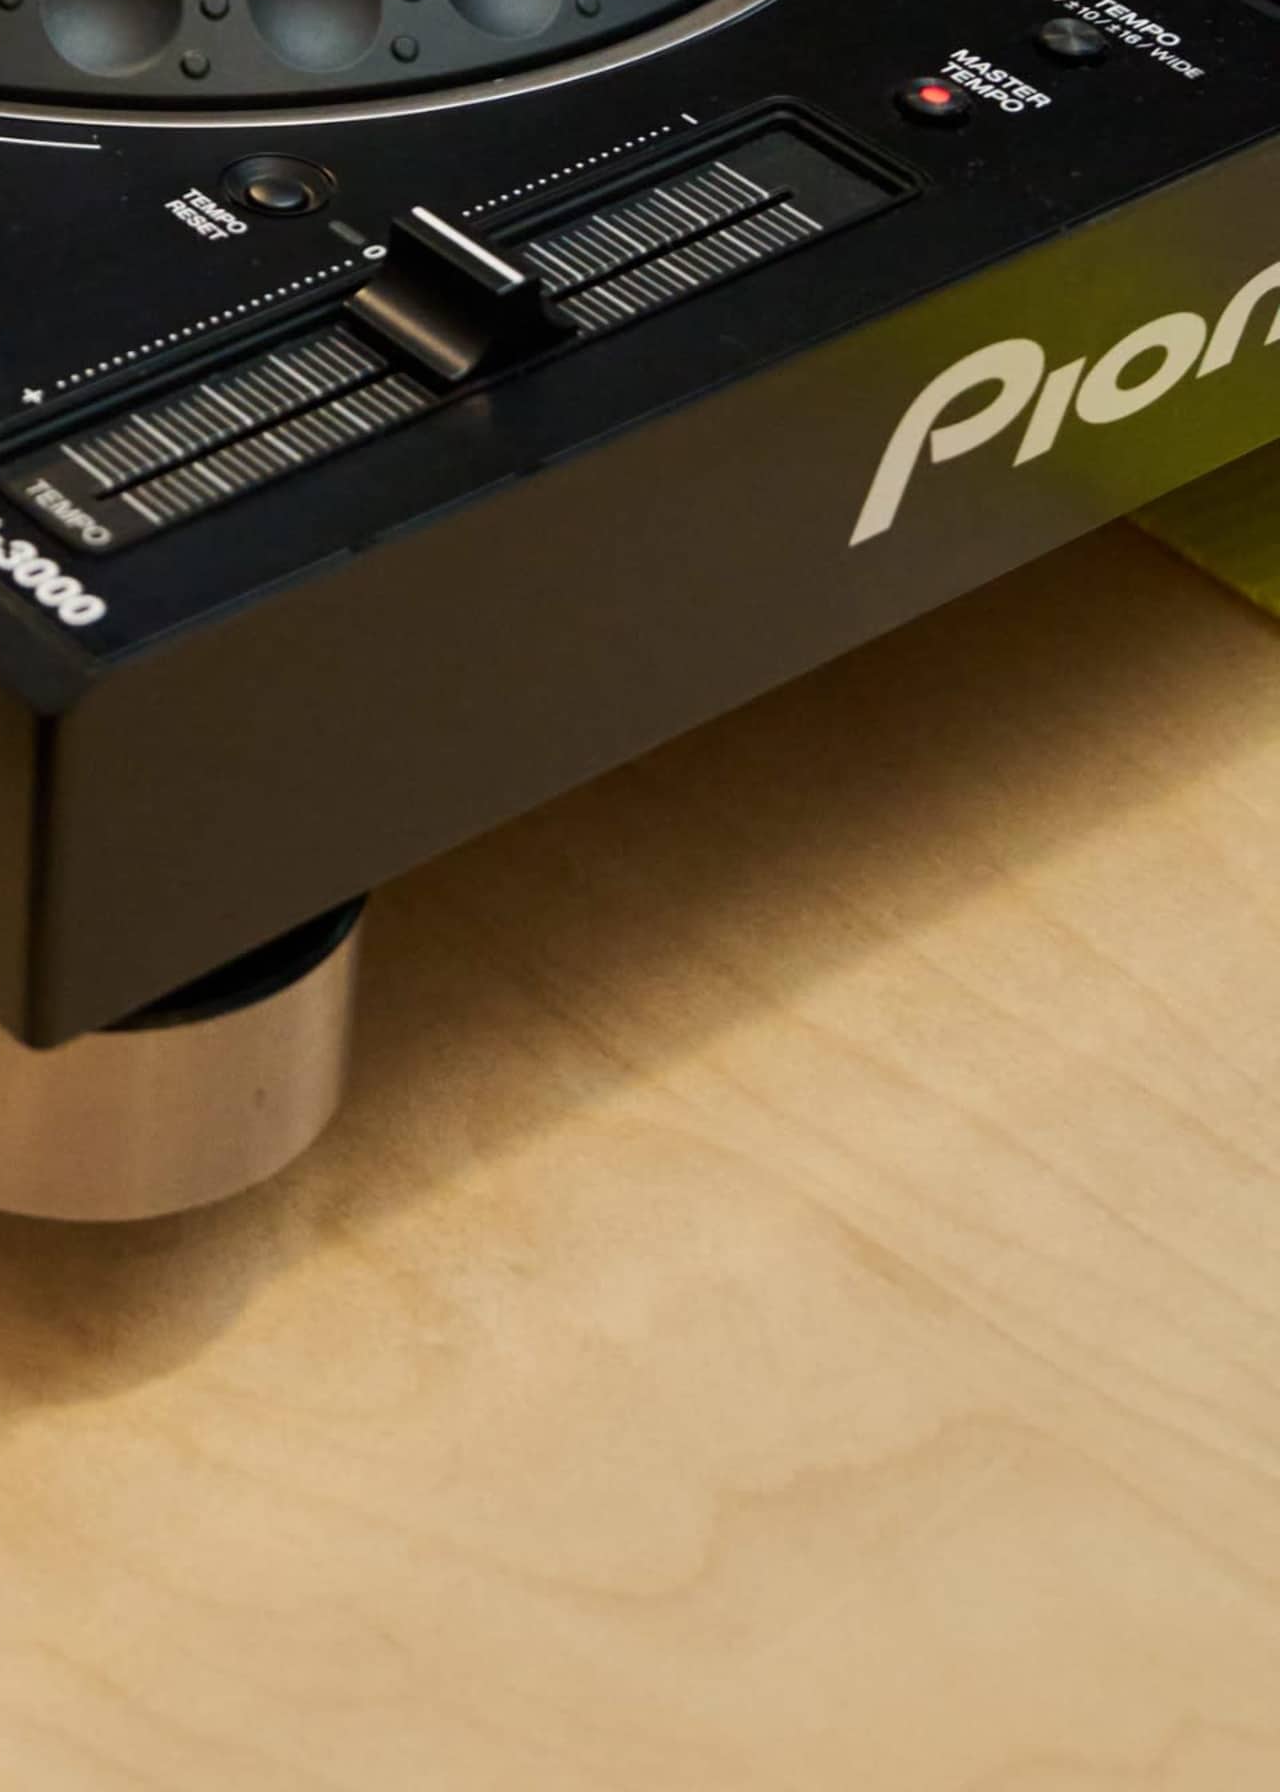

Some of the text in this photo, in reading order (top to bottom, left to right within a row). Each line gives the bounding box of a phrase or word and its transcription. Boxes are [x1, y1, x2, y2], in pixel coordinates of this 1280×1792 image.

[940, 61, 1025, 113] TEMPO
[950, 49, 1052, 108] MASTER
[165, 199, 229, 242] RESET
[183, 188, 248, 236] TEMPO
[25, 477, 112, 546] TEMPO
